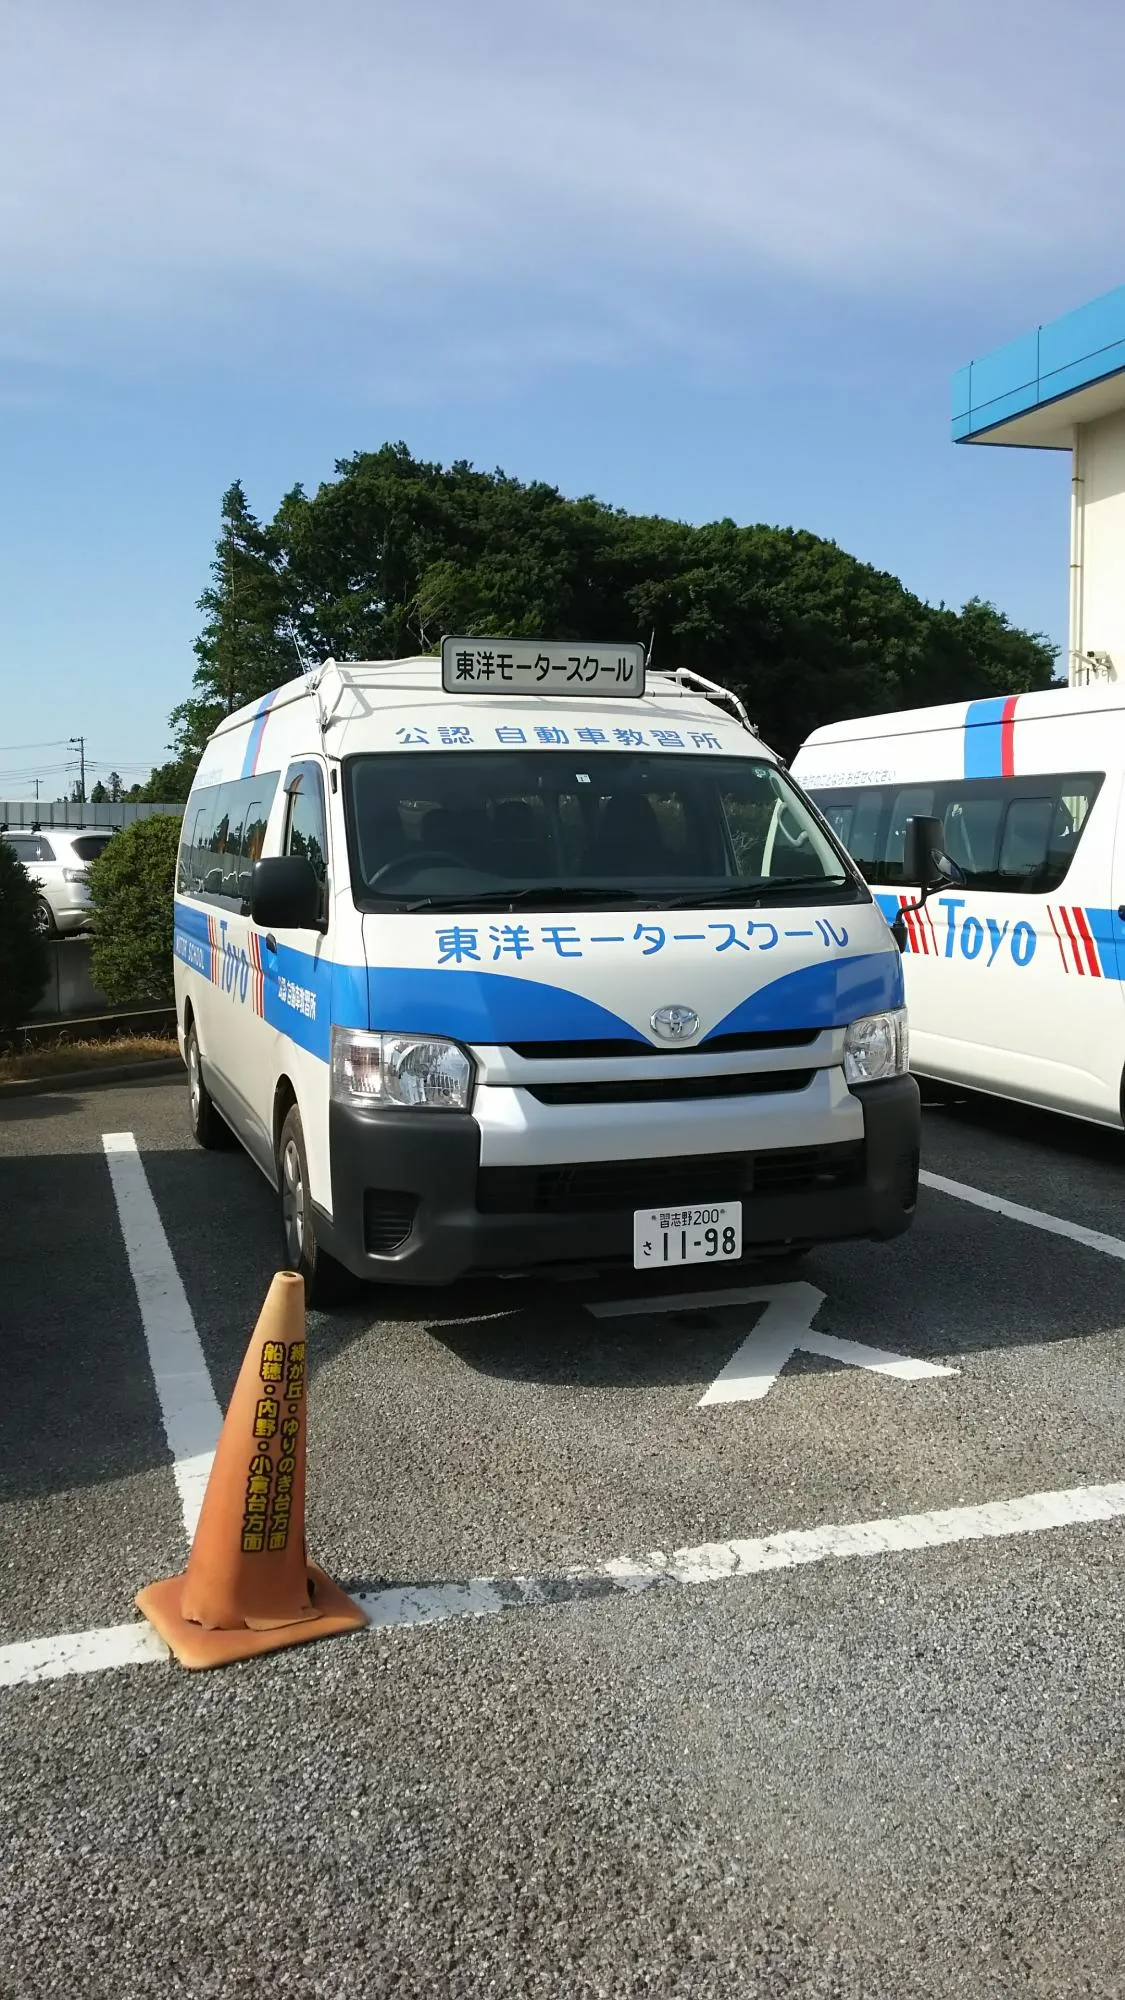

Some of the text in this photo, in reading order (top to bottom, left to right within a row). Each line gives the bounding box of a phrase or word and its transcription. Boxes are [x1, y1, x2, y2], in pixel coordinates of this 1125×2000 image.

[455, 650, 634, 682] 東洋モータースクール
[395, 726, 723, 750] 公認 自動車教習所
[434, 918, 849, 964] 東洋モータースクール
[939, 897, 1037, 967] Toyo
[642, 1226, 736, 1261] さ 11-98
